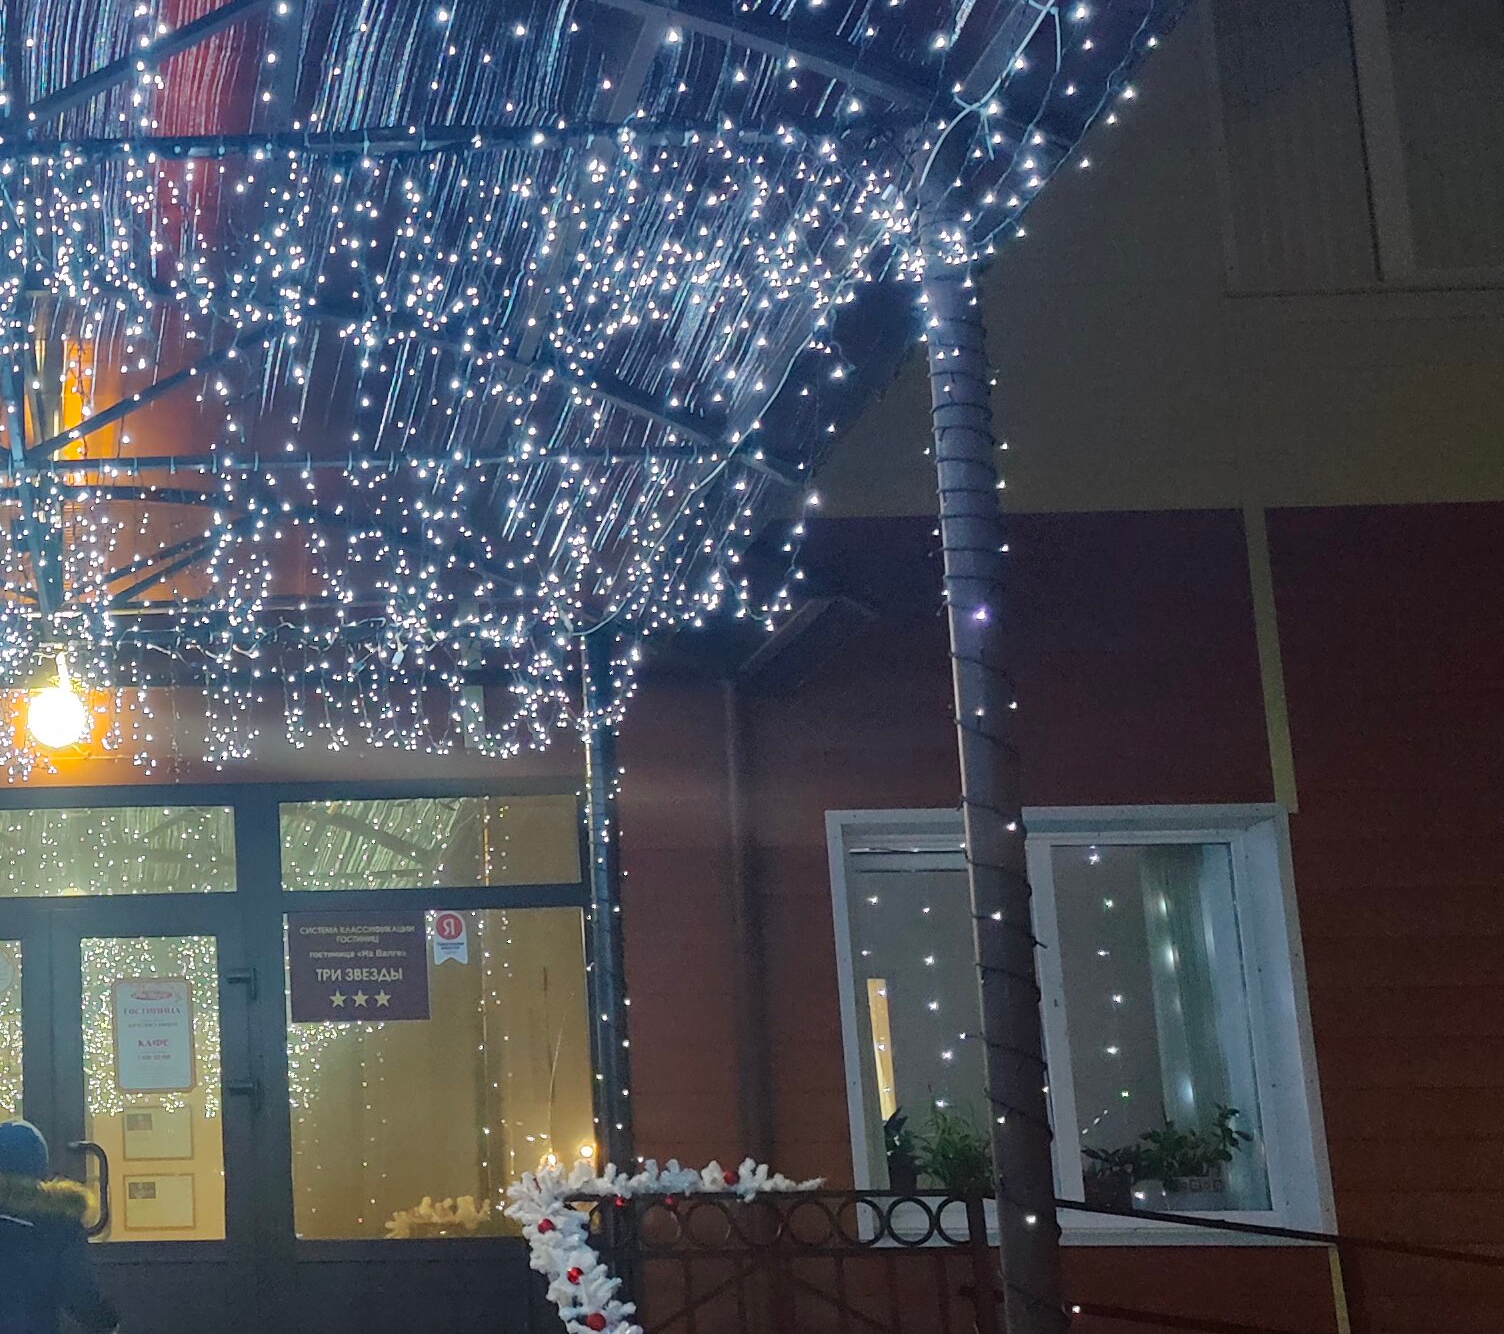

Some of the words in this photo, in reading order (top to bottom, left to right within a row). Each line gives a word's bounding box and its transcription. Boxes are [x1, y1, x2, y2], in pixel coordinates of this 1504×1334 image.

[299, 926, 338, 935] СИСТЕМА
[339, 925, 415, 934] КЛАССИФИКАЦИИ
[336, 935, 379, 944] ГОСТИНИЦ
[316, 968, 342, 981] ТРИ
[345, 968, 403, 982] ЗВЕЗДЫ
